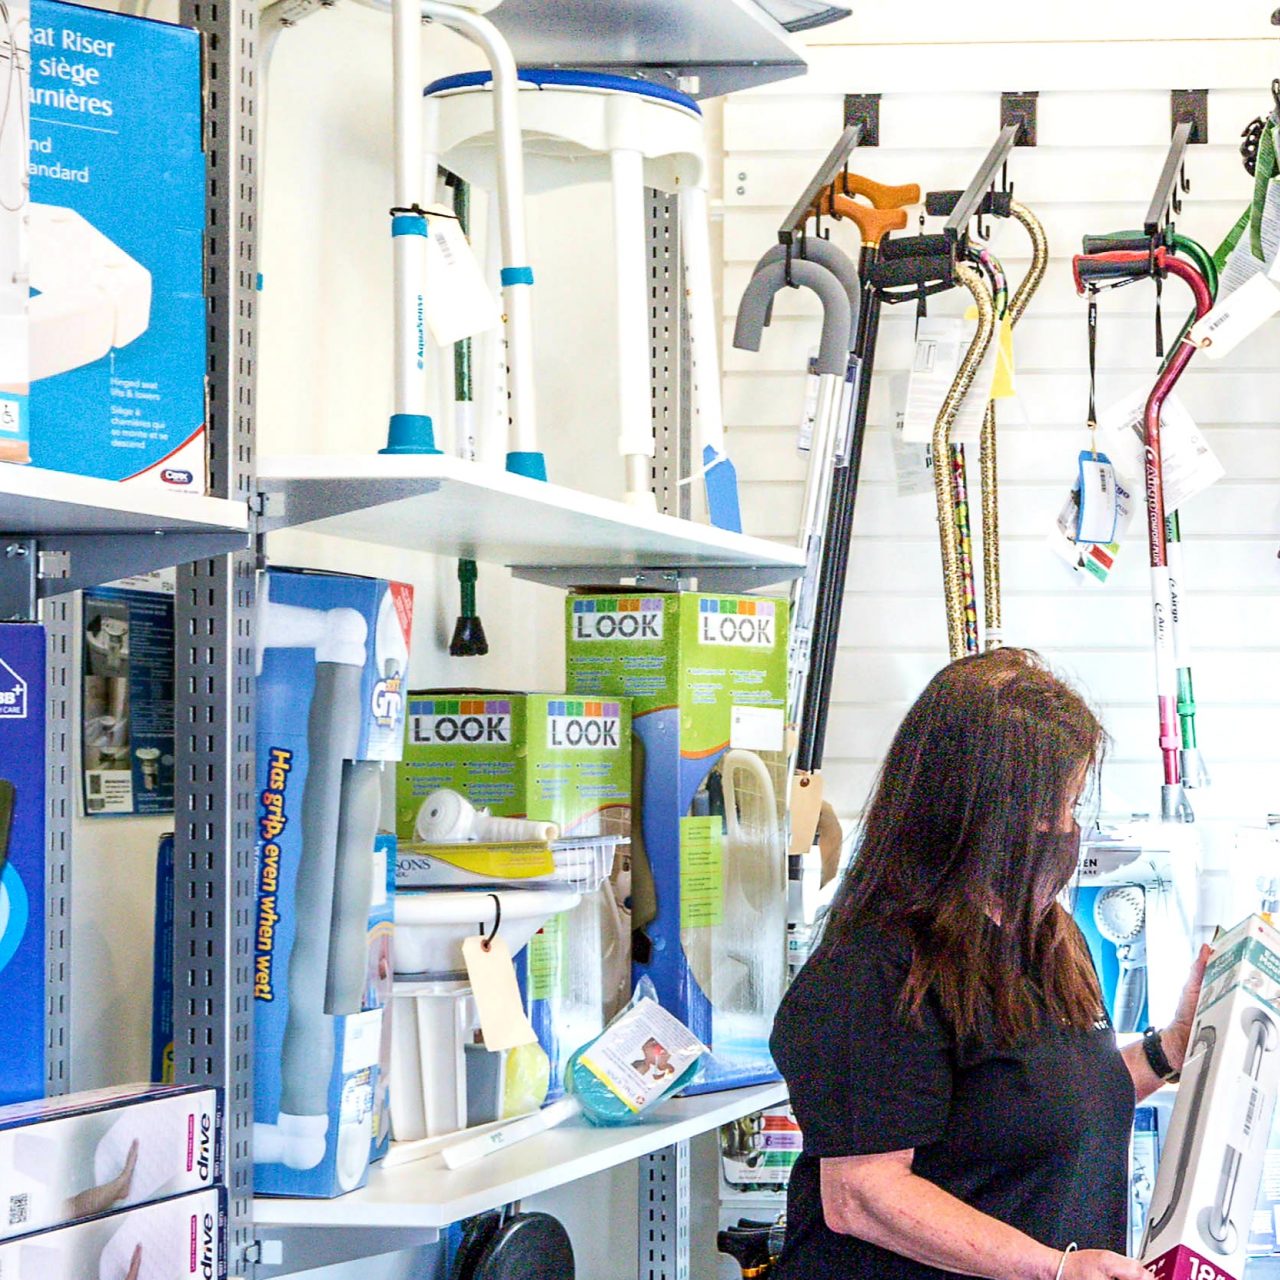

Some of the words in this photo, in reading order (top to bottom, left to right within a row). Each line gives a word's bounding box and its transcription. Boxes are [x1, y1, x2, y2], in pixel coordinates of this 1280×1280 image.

[62, 29, 116, 58] Riser
[39, 56, 100, 87] siège
[1146, 464, 1160, 512] Airgo
[578, 614, 659, 638] LOOK
[1170, 590, 1178, 623] Airgo
[703, 616, 772, 644] LOOK
[414, 717, 507, 742] LOOK
[552, 719, 617, 746] LOOK
[270, 749, 290, 791] Has
[262, 792, 287, 840] grip,
[263, 844, 280, 892] even
[258, 896, 281, 951] when
[254, 955, 273, 1001] wet!
[197, 1113, 210, 1181] drive
[201, 1213, 214, 1280] drive
